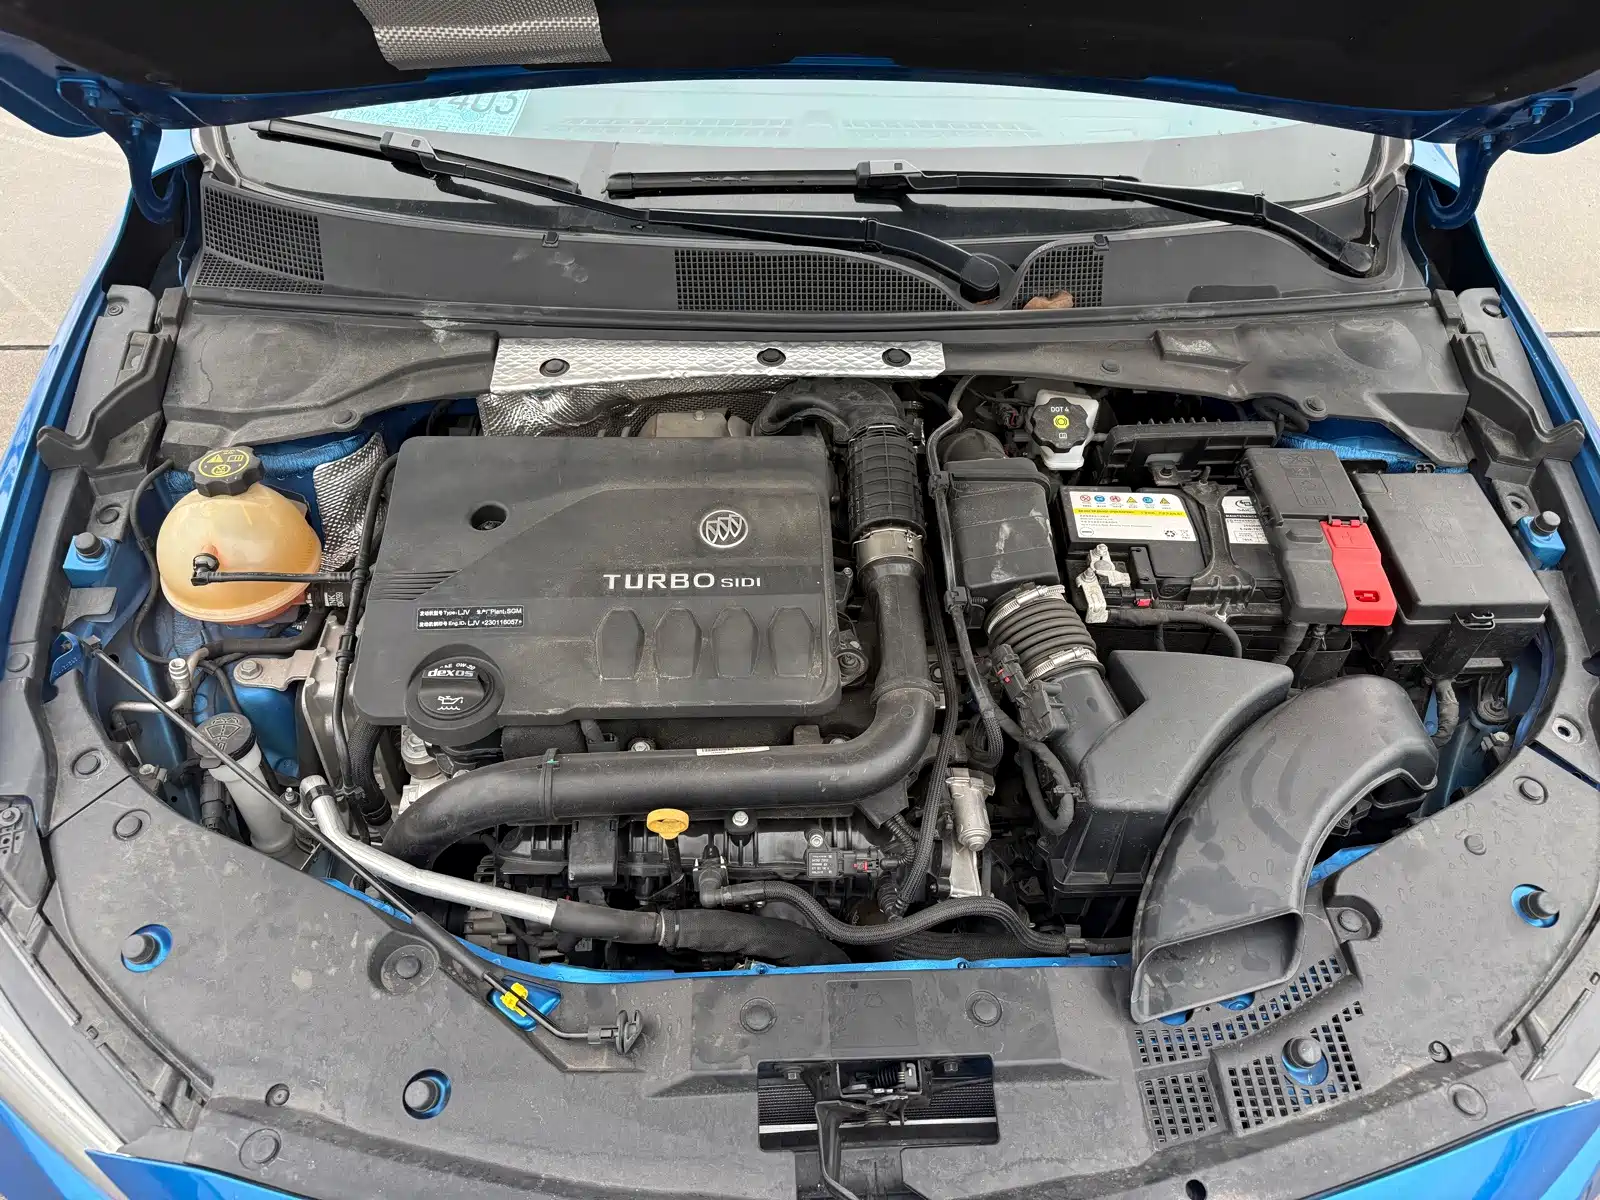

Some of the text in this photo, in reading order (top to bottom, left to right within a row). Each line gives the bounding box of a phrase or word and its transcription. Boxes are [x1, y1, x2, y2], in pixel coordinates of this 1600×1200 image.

[603, 573, 761, 589] TURBO SIDI
[428, 668, 474, 677] dexos
